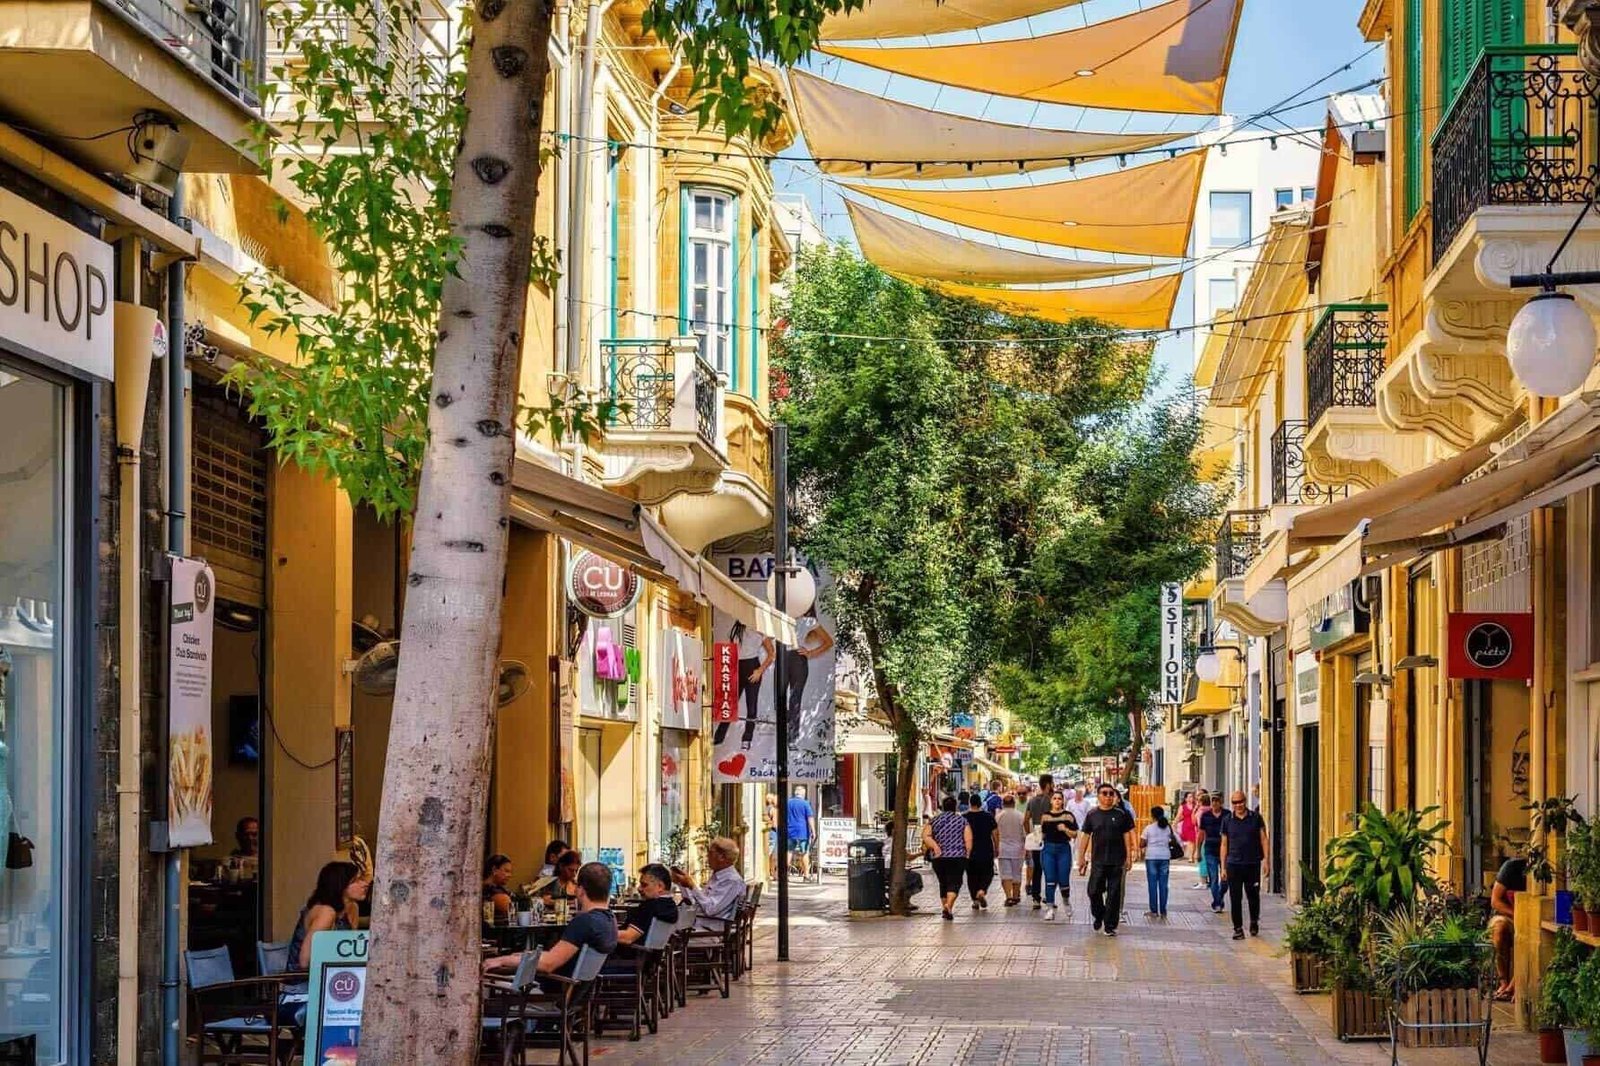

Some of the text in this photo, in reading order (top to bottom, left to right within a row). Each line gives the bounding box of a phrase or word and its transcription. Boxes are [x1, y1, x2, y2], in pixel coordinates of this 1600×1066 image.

[0, 220, 107, 340] SHOP
[721, 646, 731, 719] KRASHIAS
[749, 766, 776, 778] Back
